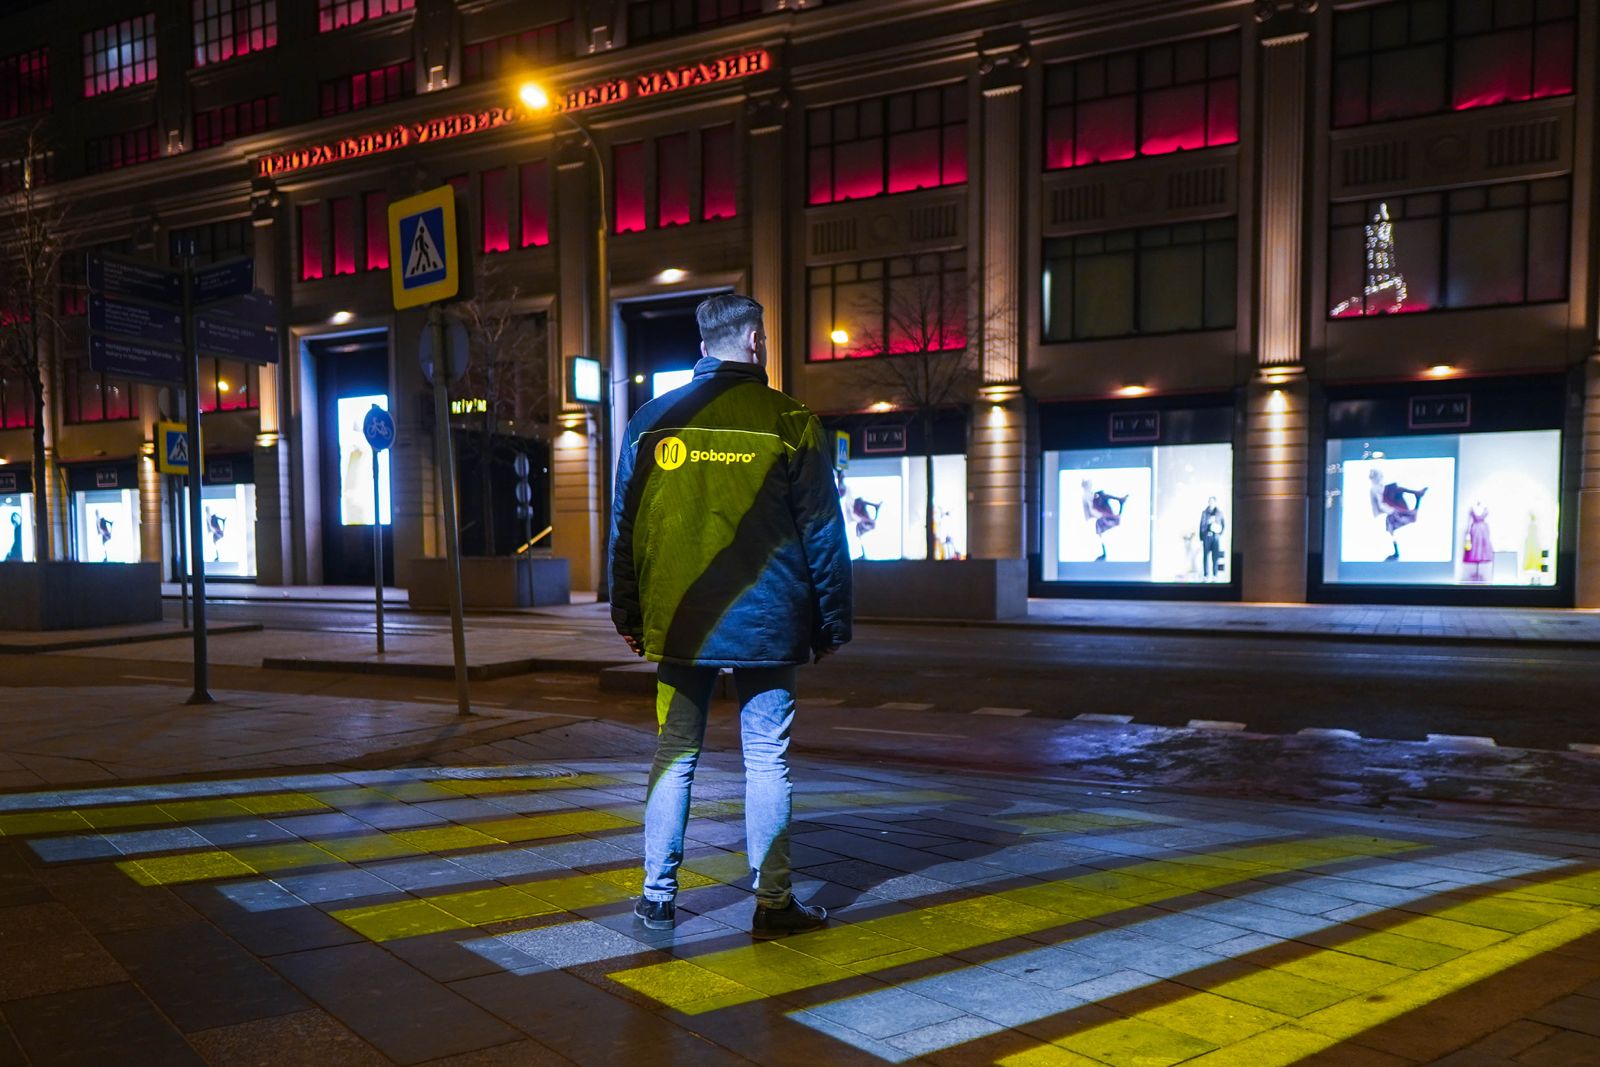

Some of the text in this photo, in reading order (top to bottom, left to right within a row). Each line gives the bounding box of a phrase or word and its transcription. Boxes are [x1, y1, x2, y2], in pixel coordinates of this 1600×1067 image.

[258, 51, 762, 176] ЦЕНТРАЛЬНЫЙ УНИВЕРСЬНЫЙ МАГАЗИН
